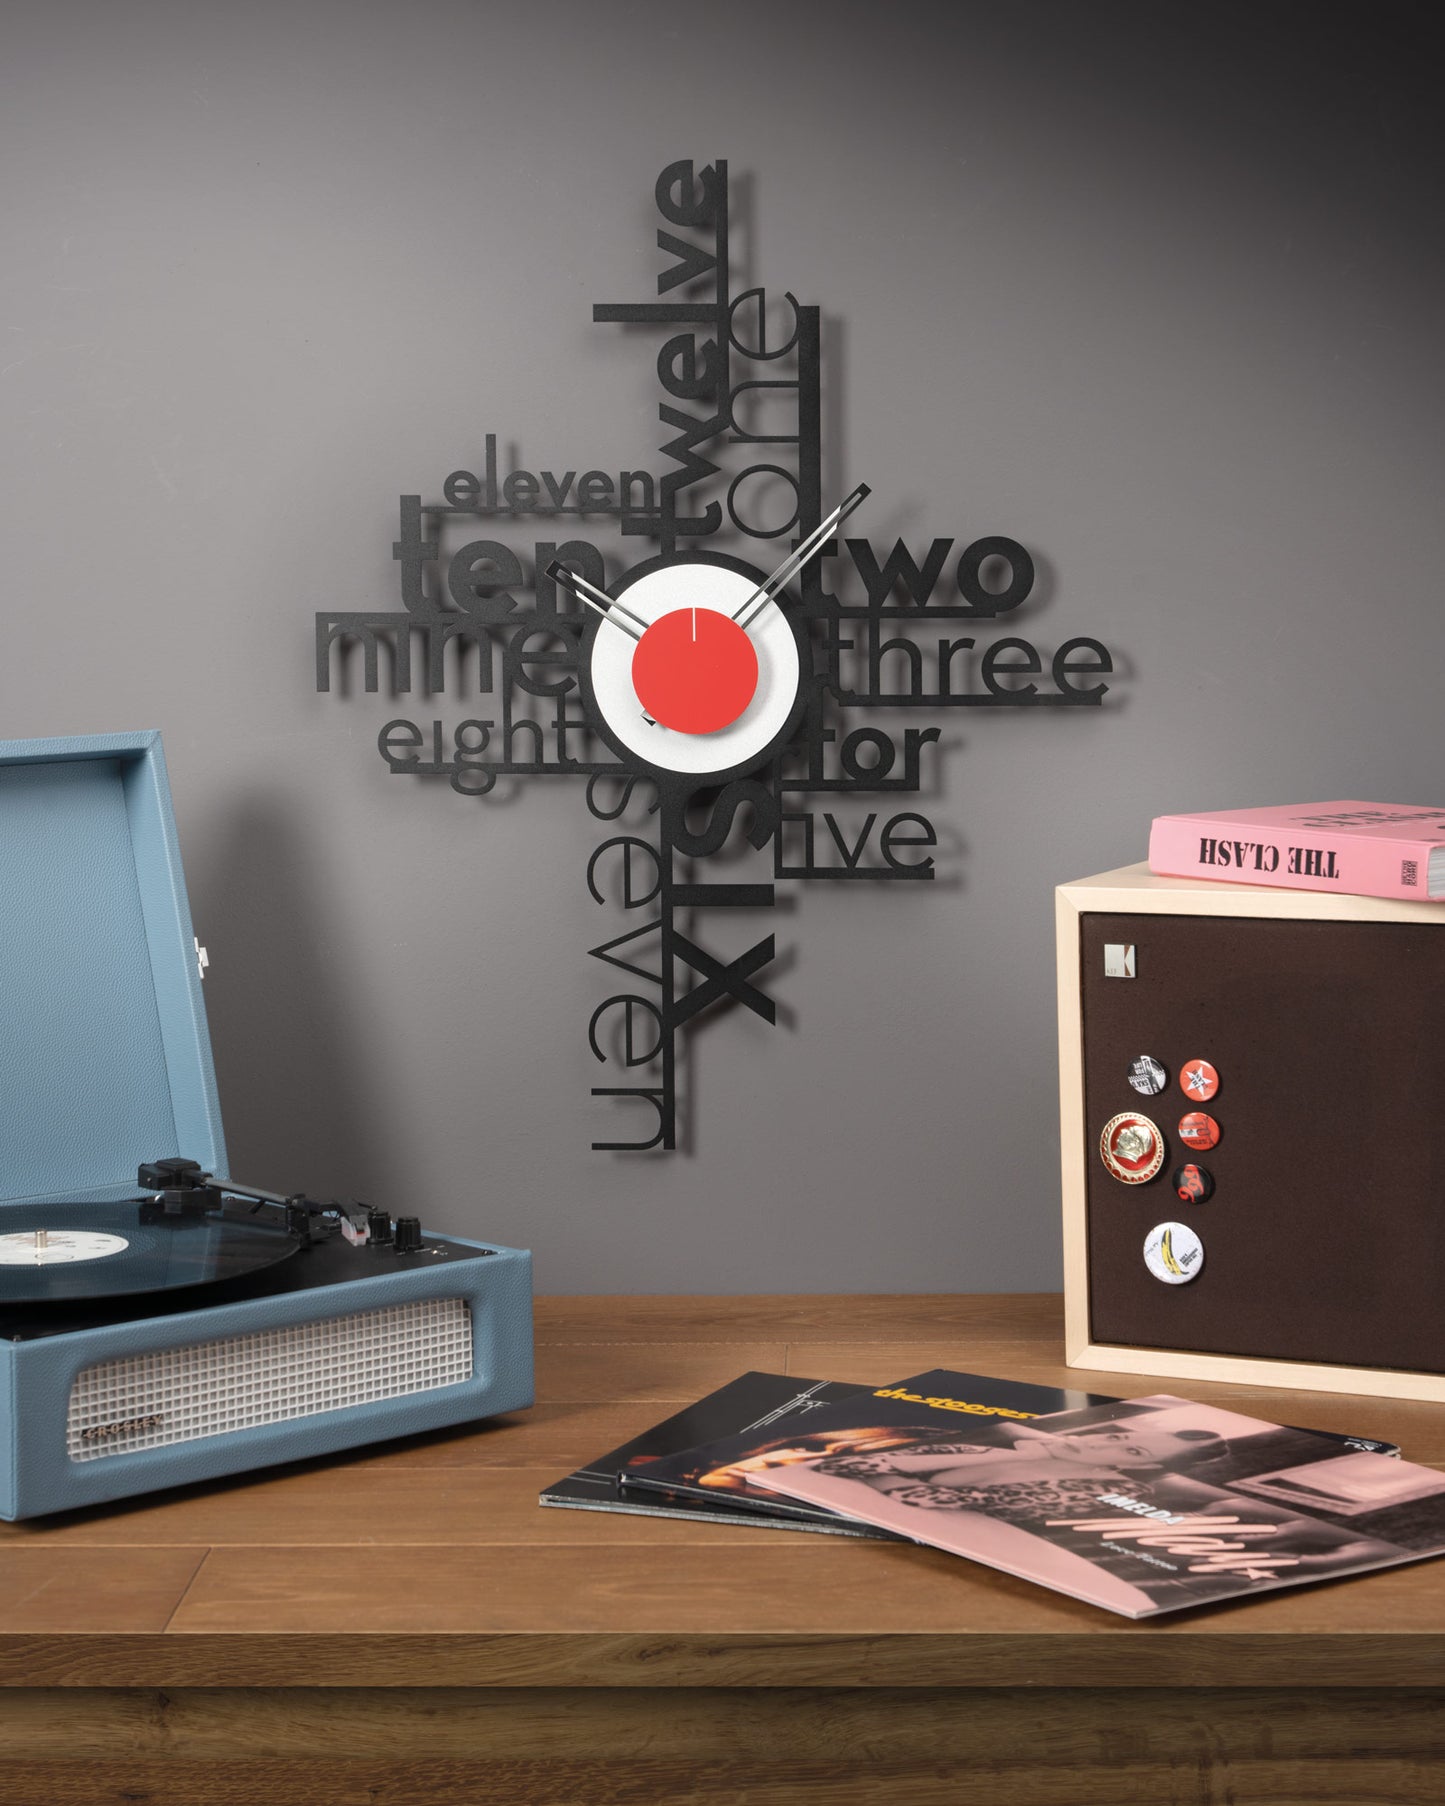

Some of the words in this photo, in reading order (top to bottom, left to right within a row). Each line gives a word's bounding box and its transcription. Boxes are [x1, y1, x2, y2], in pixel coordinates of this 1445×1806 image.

[593, 159, 727, 537] twelve
[727, 288, 803, 539] one
[443, 434, 655, 508] eleven
[392, 495, 605, 617] ten
[791, 536, 1035, 613] two
[822, 616, 1113, 697] three
[377, 654, 594, 796] eight
[1198, 838, 1280, 873] CLASH
[1288, 847, 1340, 879] THE
[668, 778, 776, 1026] six
[586, 772, 665, 1150] seven
[84, 1414, 163, 1440] CROSLEY
[873, 1388, 923, 1403] the
[1096, 1493, 1185, 1526] IMELDA
